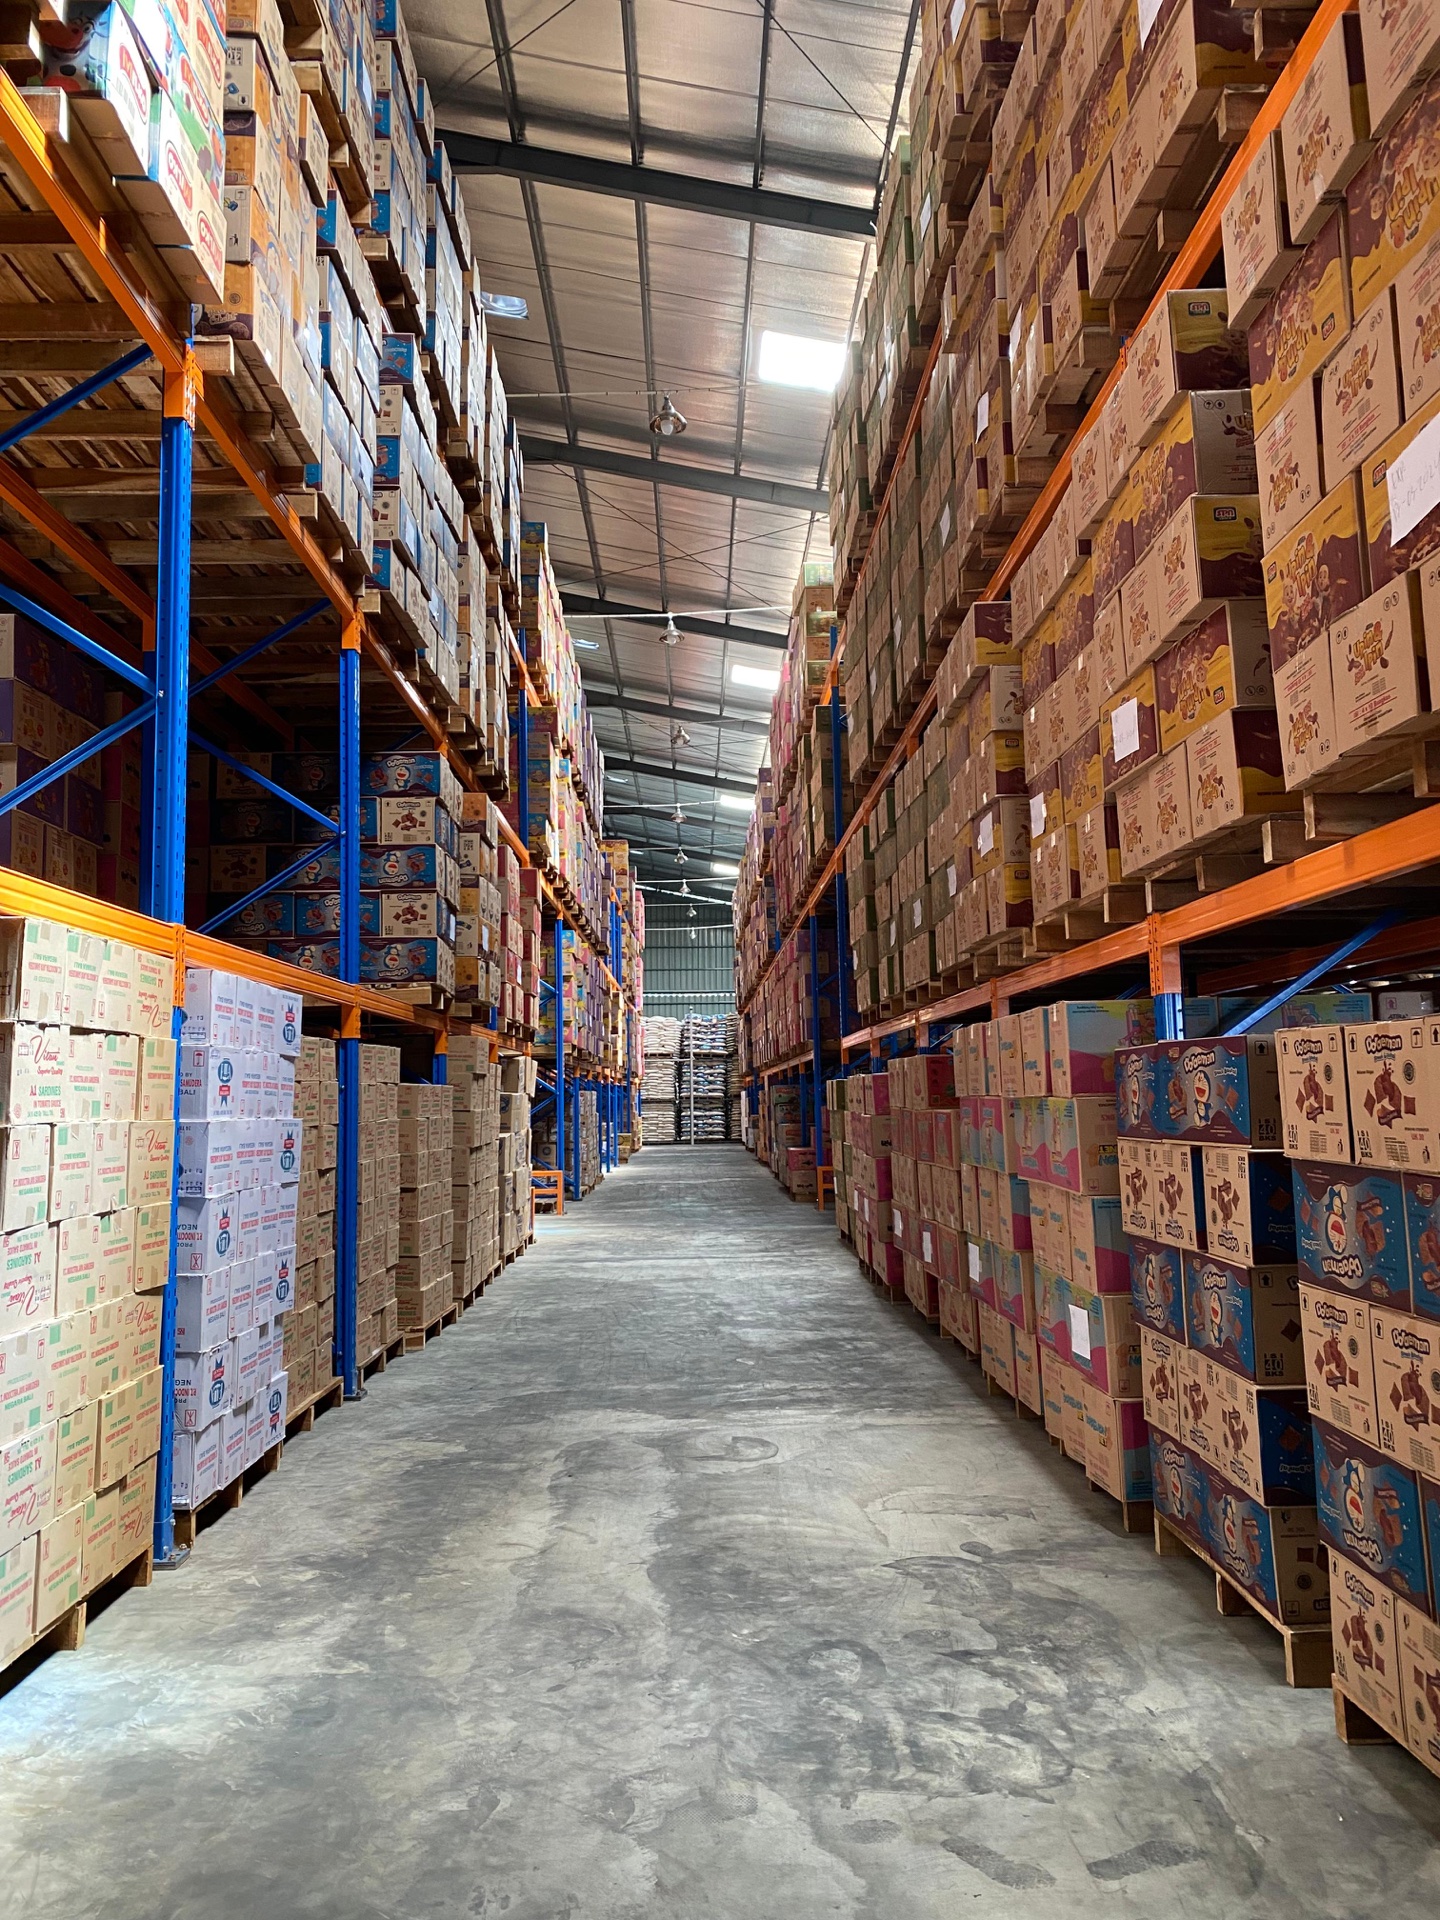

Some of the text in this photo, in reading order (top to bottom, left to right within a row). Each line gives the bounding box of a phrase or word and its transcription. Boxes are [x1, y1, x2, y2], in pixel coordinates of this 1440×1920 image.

[30, 1035, 60, 1064] Vitan
[1294, 1039, 1323, 1057] Doraemon
[1365, 1035, 1402, 1056] Doraemon
[1183, 1050, 1215, 1074] Doraemon
[38, 1086, 61, 1096] SARDINES
[1258, 1124, 1277, 1136] 40
[6, 1254, 32, 1270] SARDINES
[1321, 1254, 1364, 1279] Doraemon
[1203, 1271, 1227, 1291] Doraemon
[6, 1285, 39, 1317] Vitan
[1315, 1301, 1348, 1324] Doraemon
[1391, 1328, 1430, 1355] Doraemon
[1264, 1359, 1283, 1370] 40
[1343, 1529, 1383, 1564] Doraemon
[1345, 1570, 1375, 1607] Doraemon
